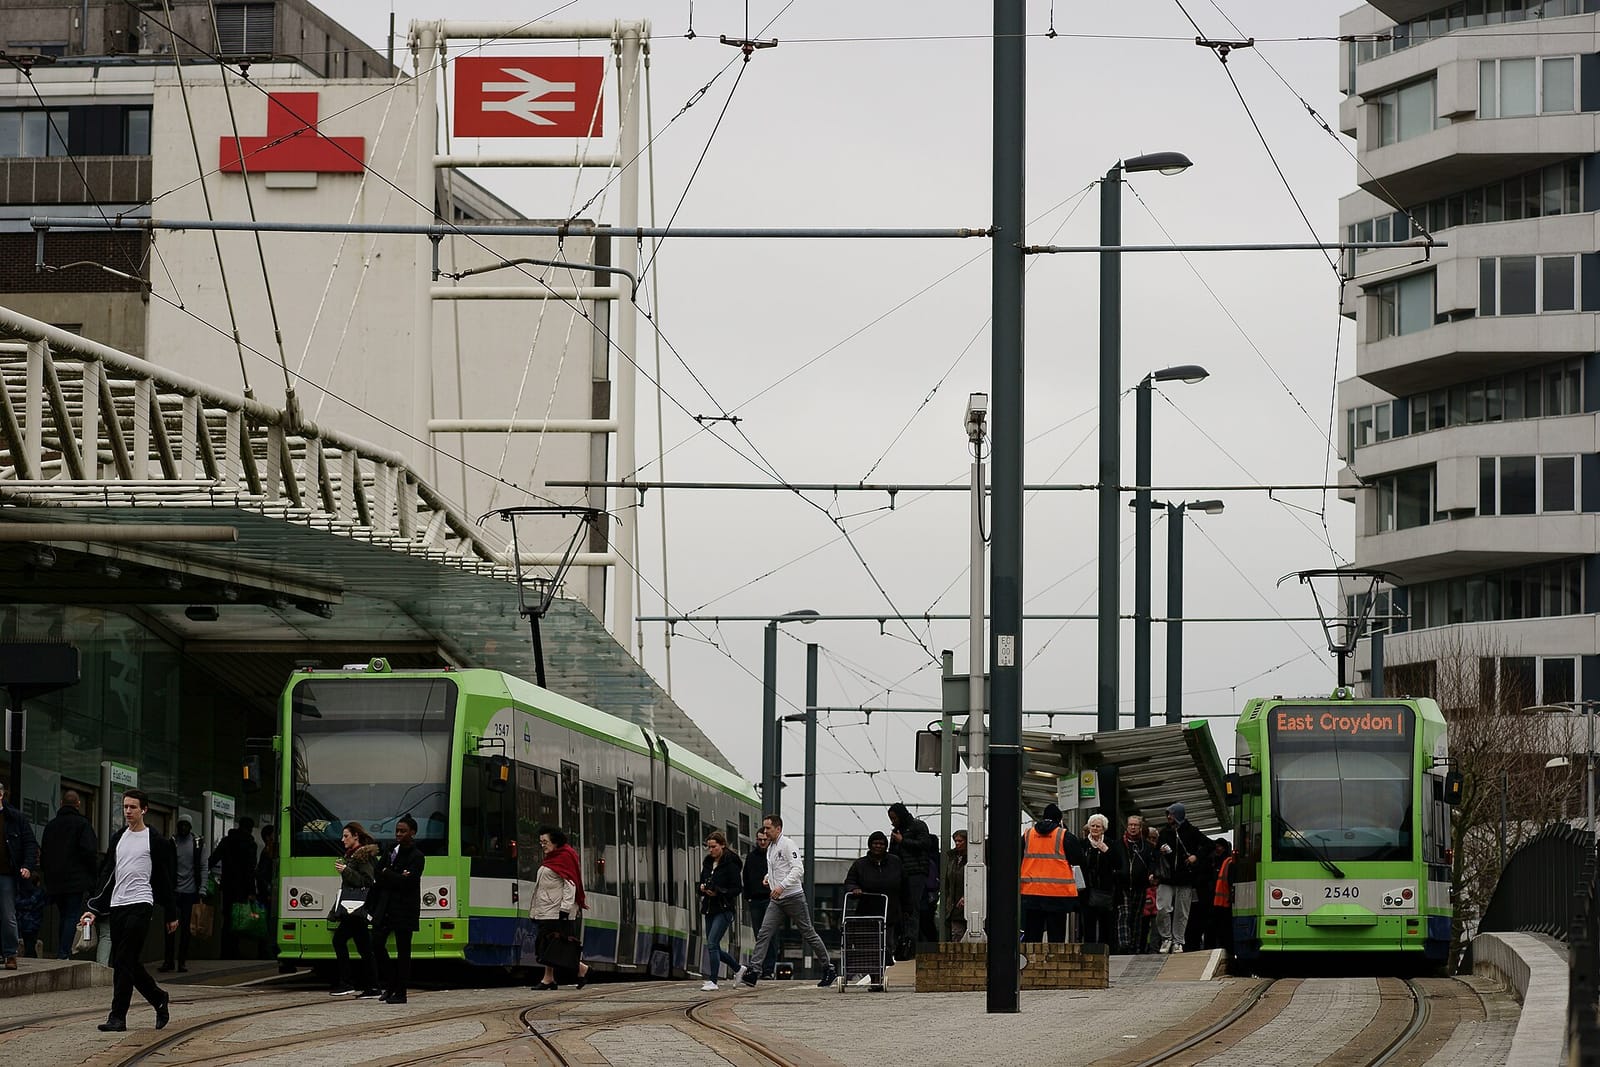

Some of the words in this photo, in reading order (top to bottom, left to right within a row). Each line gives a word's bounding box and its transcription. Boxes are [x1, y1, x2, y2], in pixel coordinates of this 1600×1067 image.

[494, 723, 510, 737] 2547
[1277, 712, 1314, 731] East
[1319, 712, 1393, 735] Croydon
[1324, 886, 1360, 898] 2540
